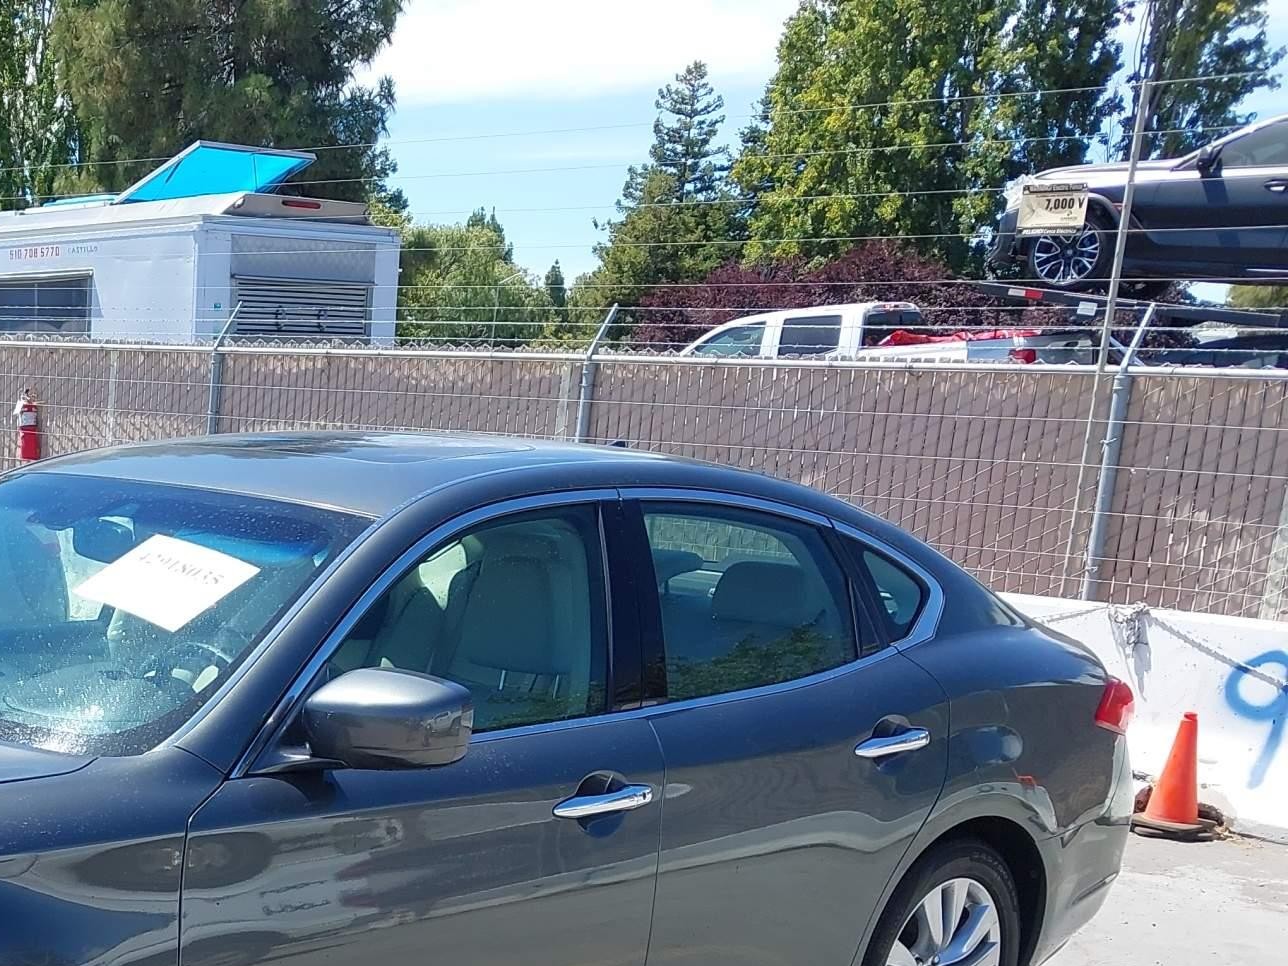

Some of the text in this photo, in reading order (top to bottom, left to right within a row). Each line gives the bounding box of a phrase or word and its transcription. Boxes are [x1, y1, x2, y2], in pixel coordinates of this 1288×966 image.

[1045, 197, 1086, 212] 7,000 V
[9, 249, 23, 260] 510
[24, 248, 39, 259] 708
[40, 246, 61, 257] 5770
